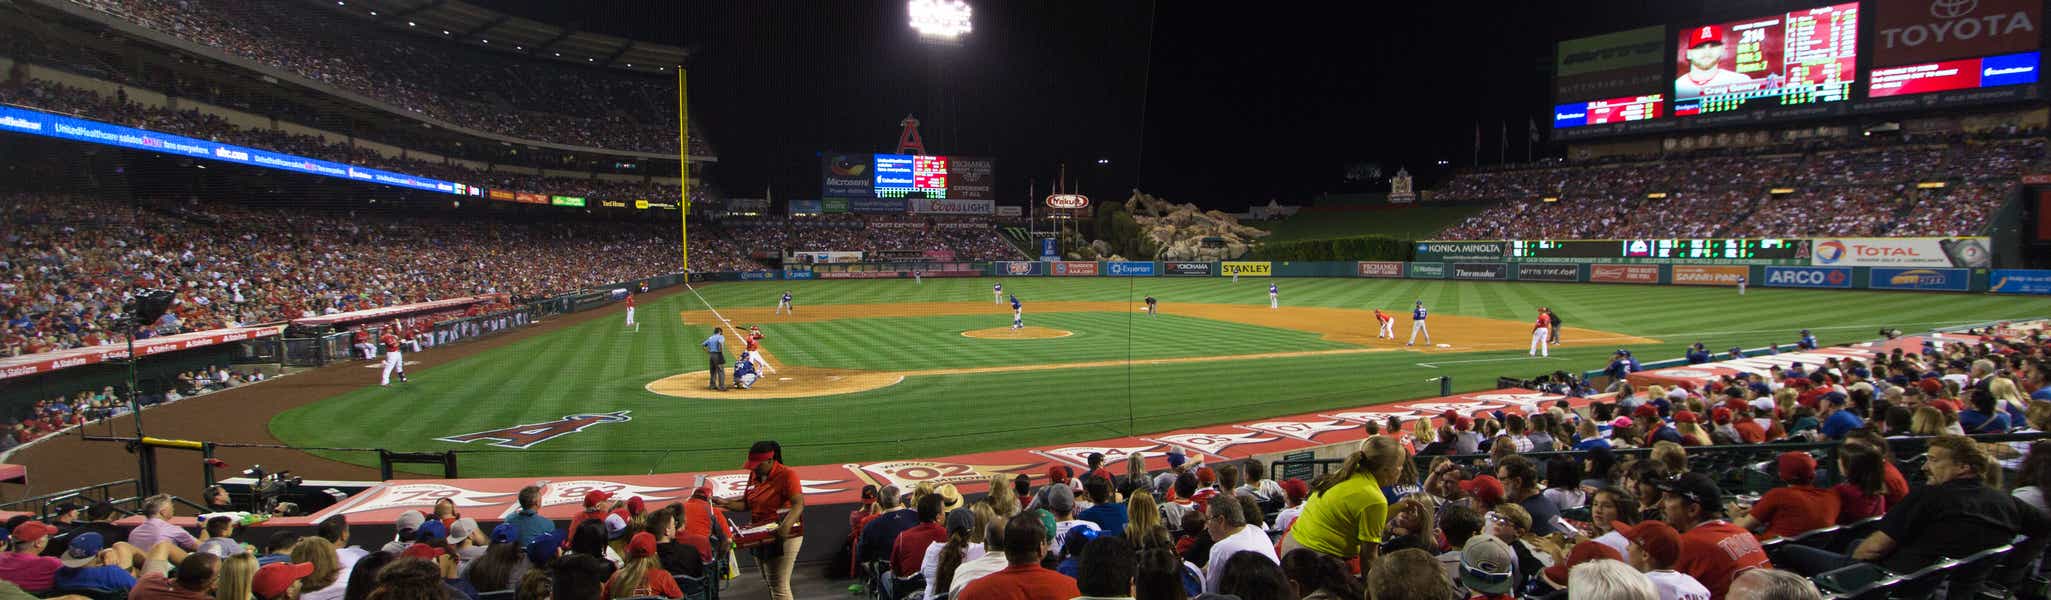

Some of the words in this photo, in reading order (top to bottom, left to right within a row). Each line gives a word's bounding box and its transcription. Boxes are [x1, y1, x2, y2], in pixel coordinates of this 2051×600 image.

[1879, 11, 2034, 49] TOYOTA
[960, 202, 990, 212] LIGHT
[1429, 245, 1461, 253] KONICA
[1462, 244, 1500, 253] MINOLTA
[1852, 244, 1921, 257] TOTAL
[1123, 262, 1151, 274] Experian
[1223, 265, 1269, 273] STANLEY
[1456, 269, 1496, 277] Thermador
[1769, 271, 1824, 284] ARCO
